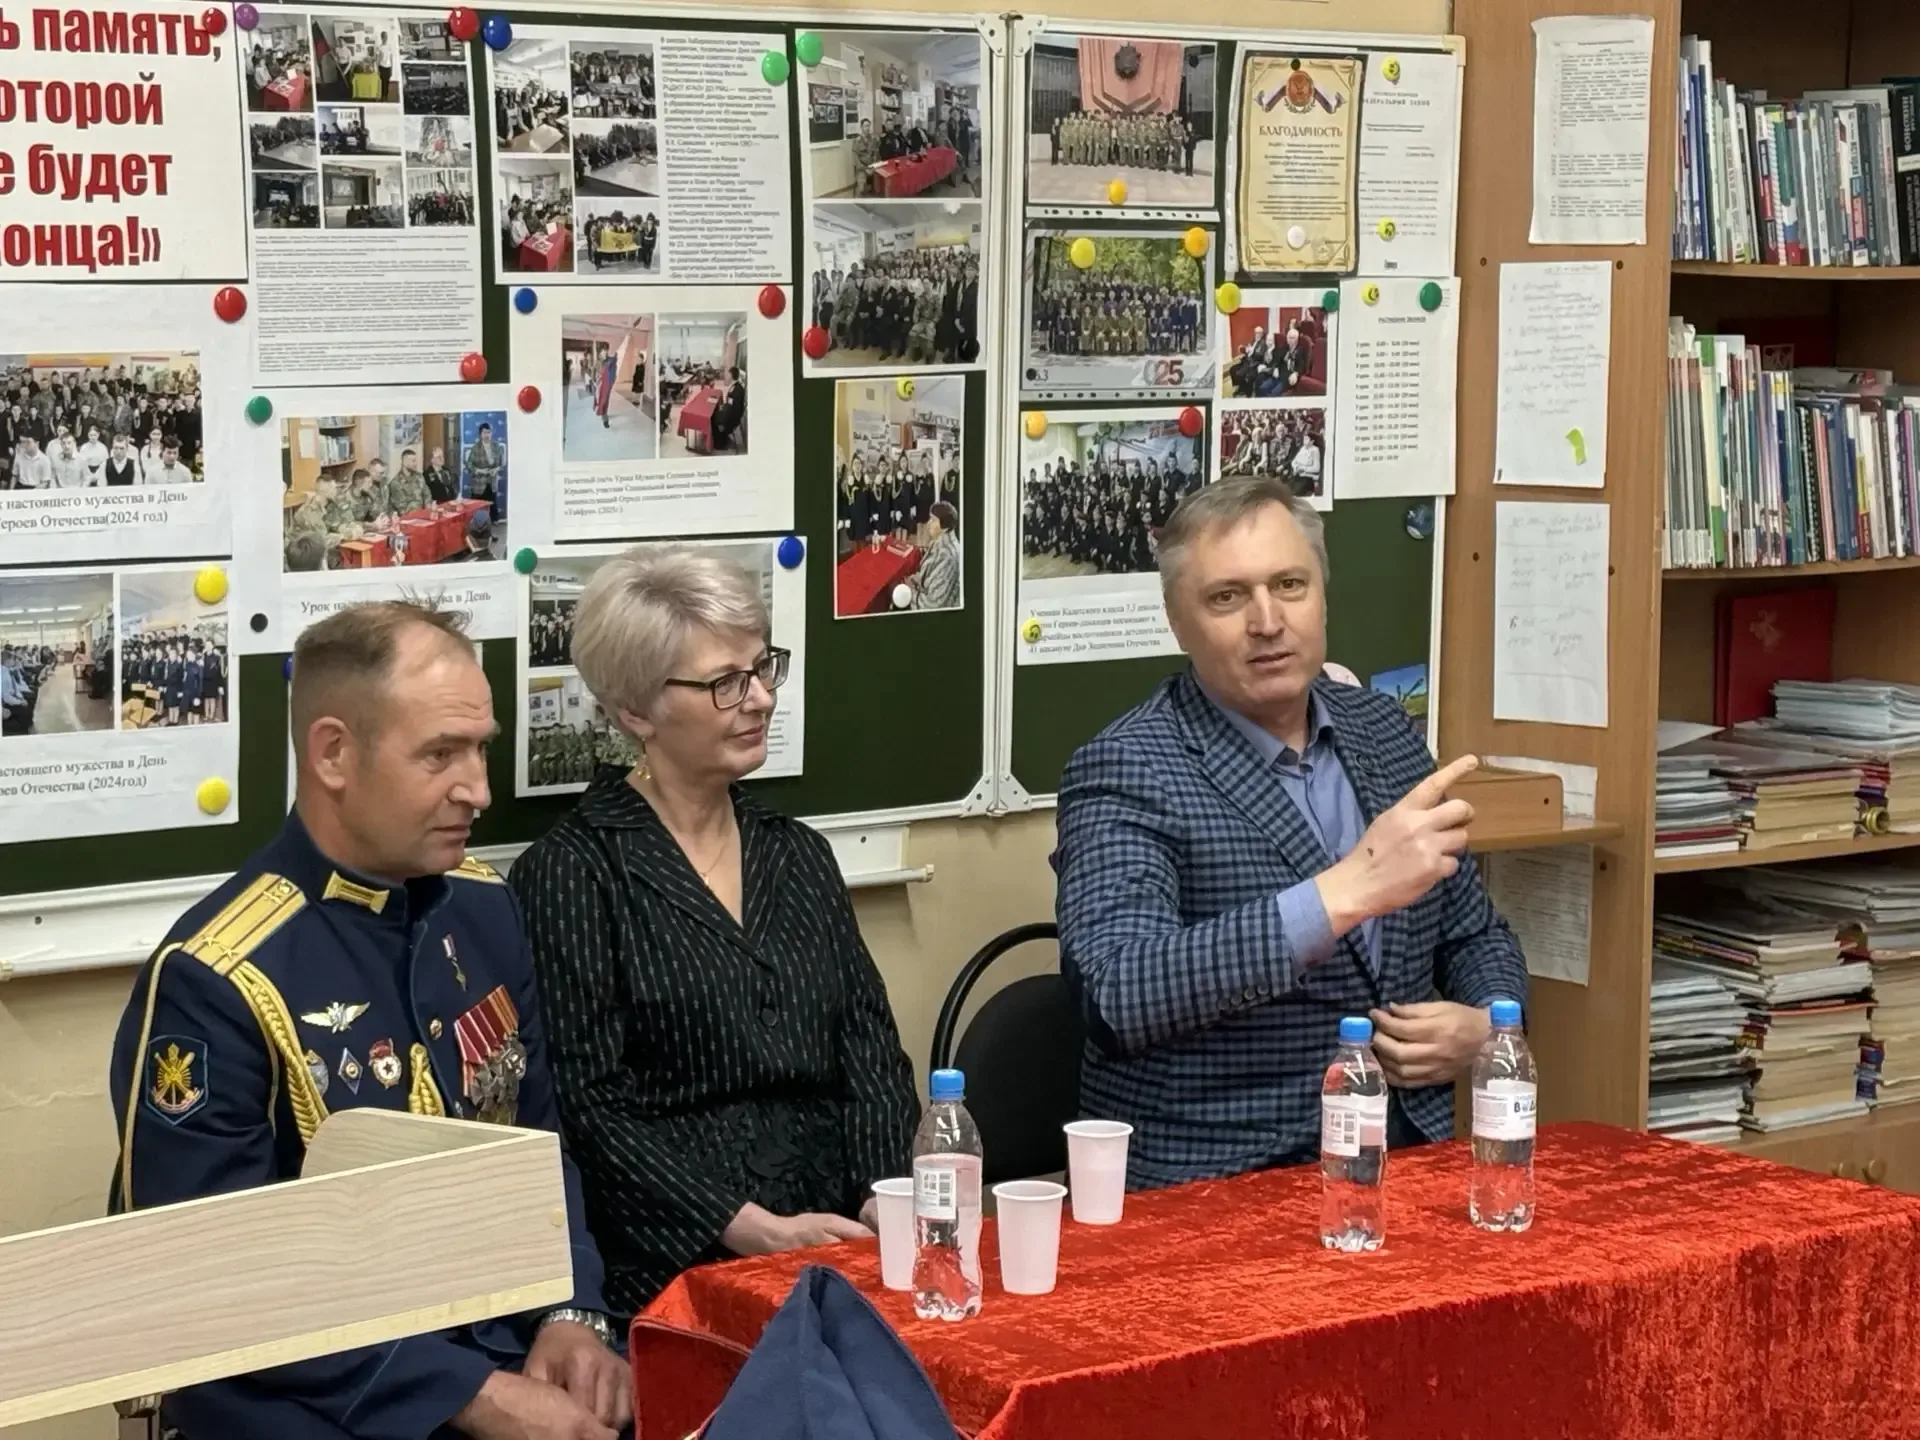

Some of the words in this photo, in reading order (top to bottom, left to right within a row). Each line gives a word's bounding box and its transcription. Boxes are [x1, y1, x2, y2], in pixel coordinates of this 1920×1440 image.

[32, 8, 221, 62] память,
[0, 72, 163, 129] оторой
[1259, 125, 1343, 138] БЛАГОДАРНОСТЬ
[28, 144, 172, 203] будет
[0, 216, 160, 273] онца!»
[7, 498, 81, 510] настоящего
[85, 495, 144, 509] мужества
[148, 494, 155, 503] в
[158, 490, 188, 504] День
[0, 517, 38, 532] ероев
[143, 510, 168, 524] год)
[301, 601, 330, 616] Урок
[465, 590, 491, 604] День
[66, 760, 124, 776] мужества
[128, 759, 135, 768] в
[138, 755, 167, 769] День
[21, 782, 85, 795] Отечества
[89, 775, 147, 792] (2024год)
